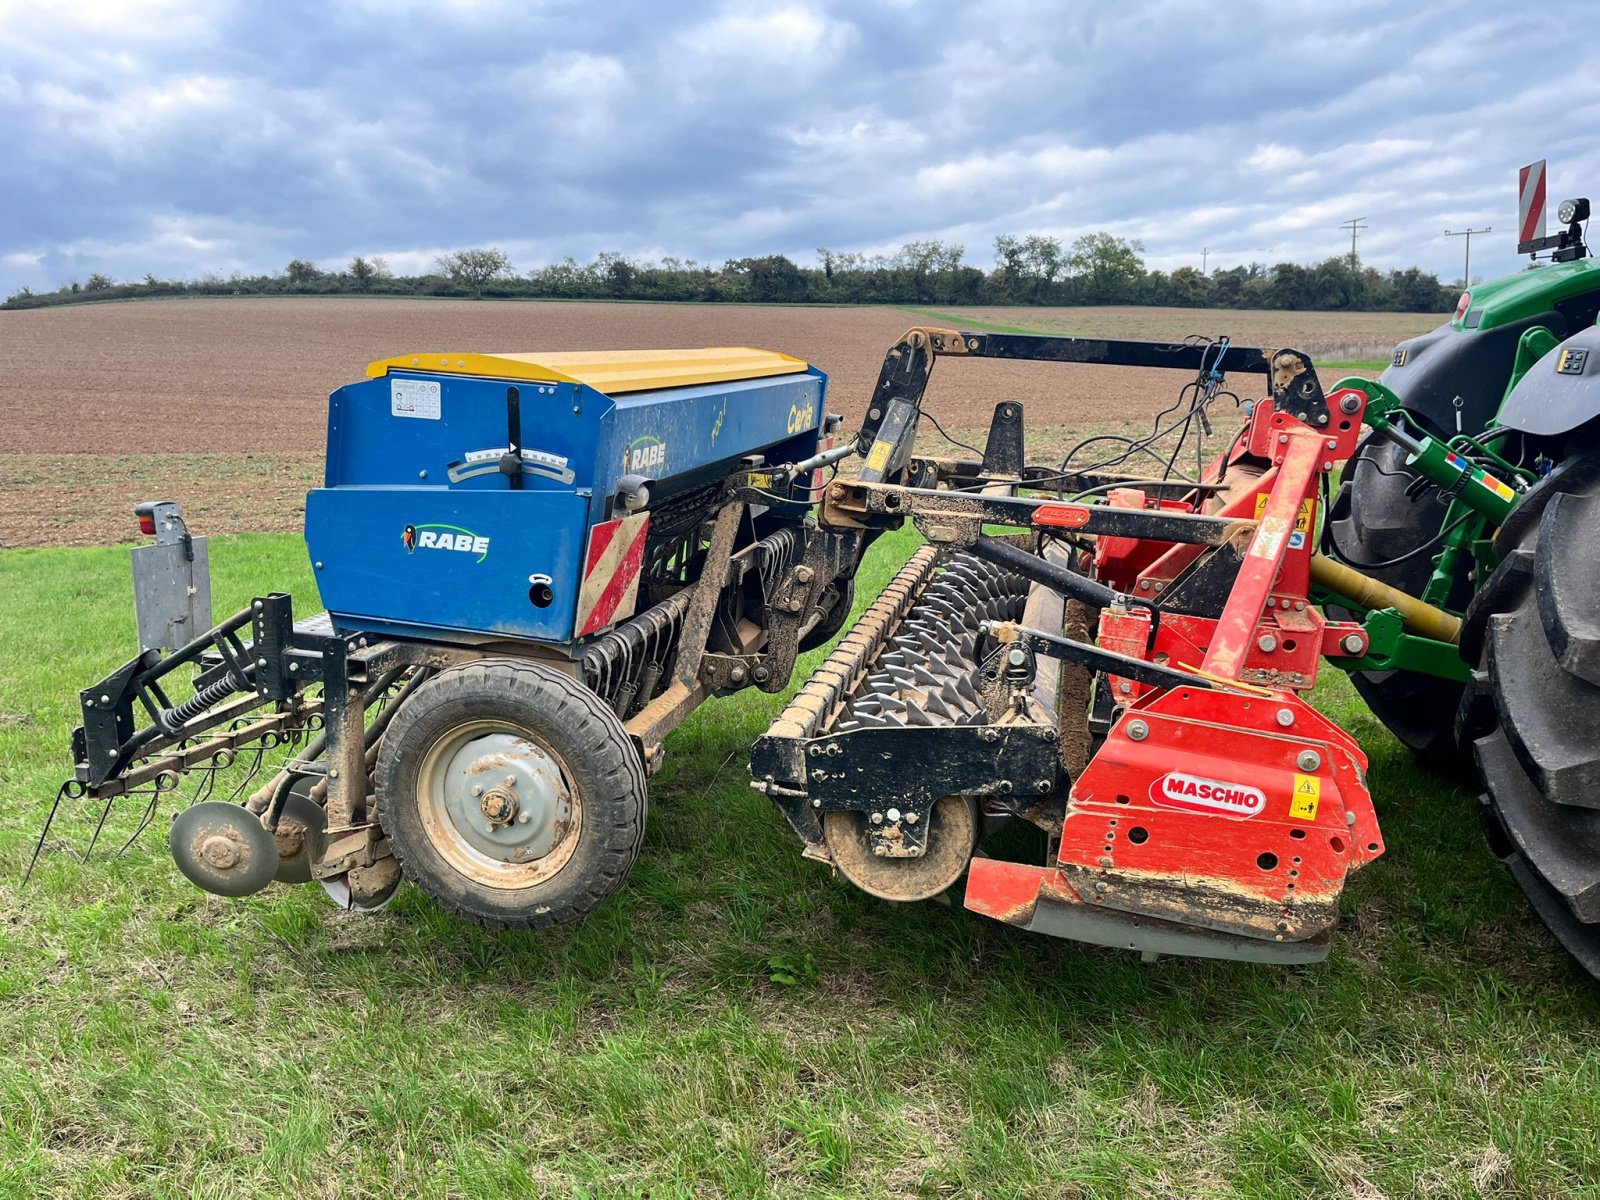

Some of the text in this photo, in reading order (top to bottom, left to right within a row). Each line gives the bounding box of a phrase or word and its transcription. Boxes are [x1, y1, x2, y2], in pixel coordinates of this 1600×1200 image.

[631, 442, 666, 471] RABE
[418, 531, 489, 554] RABE
[1166, 778, 1259, 808] MASCHIO
